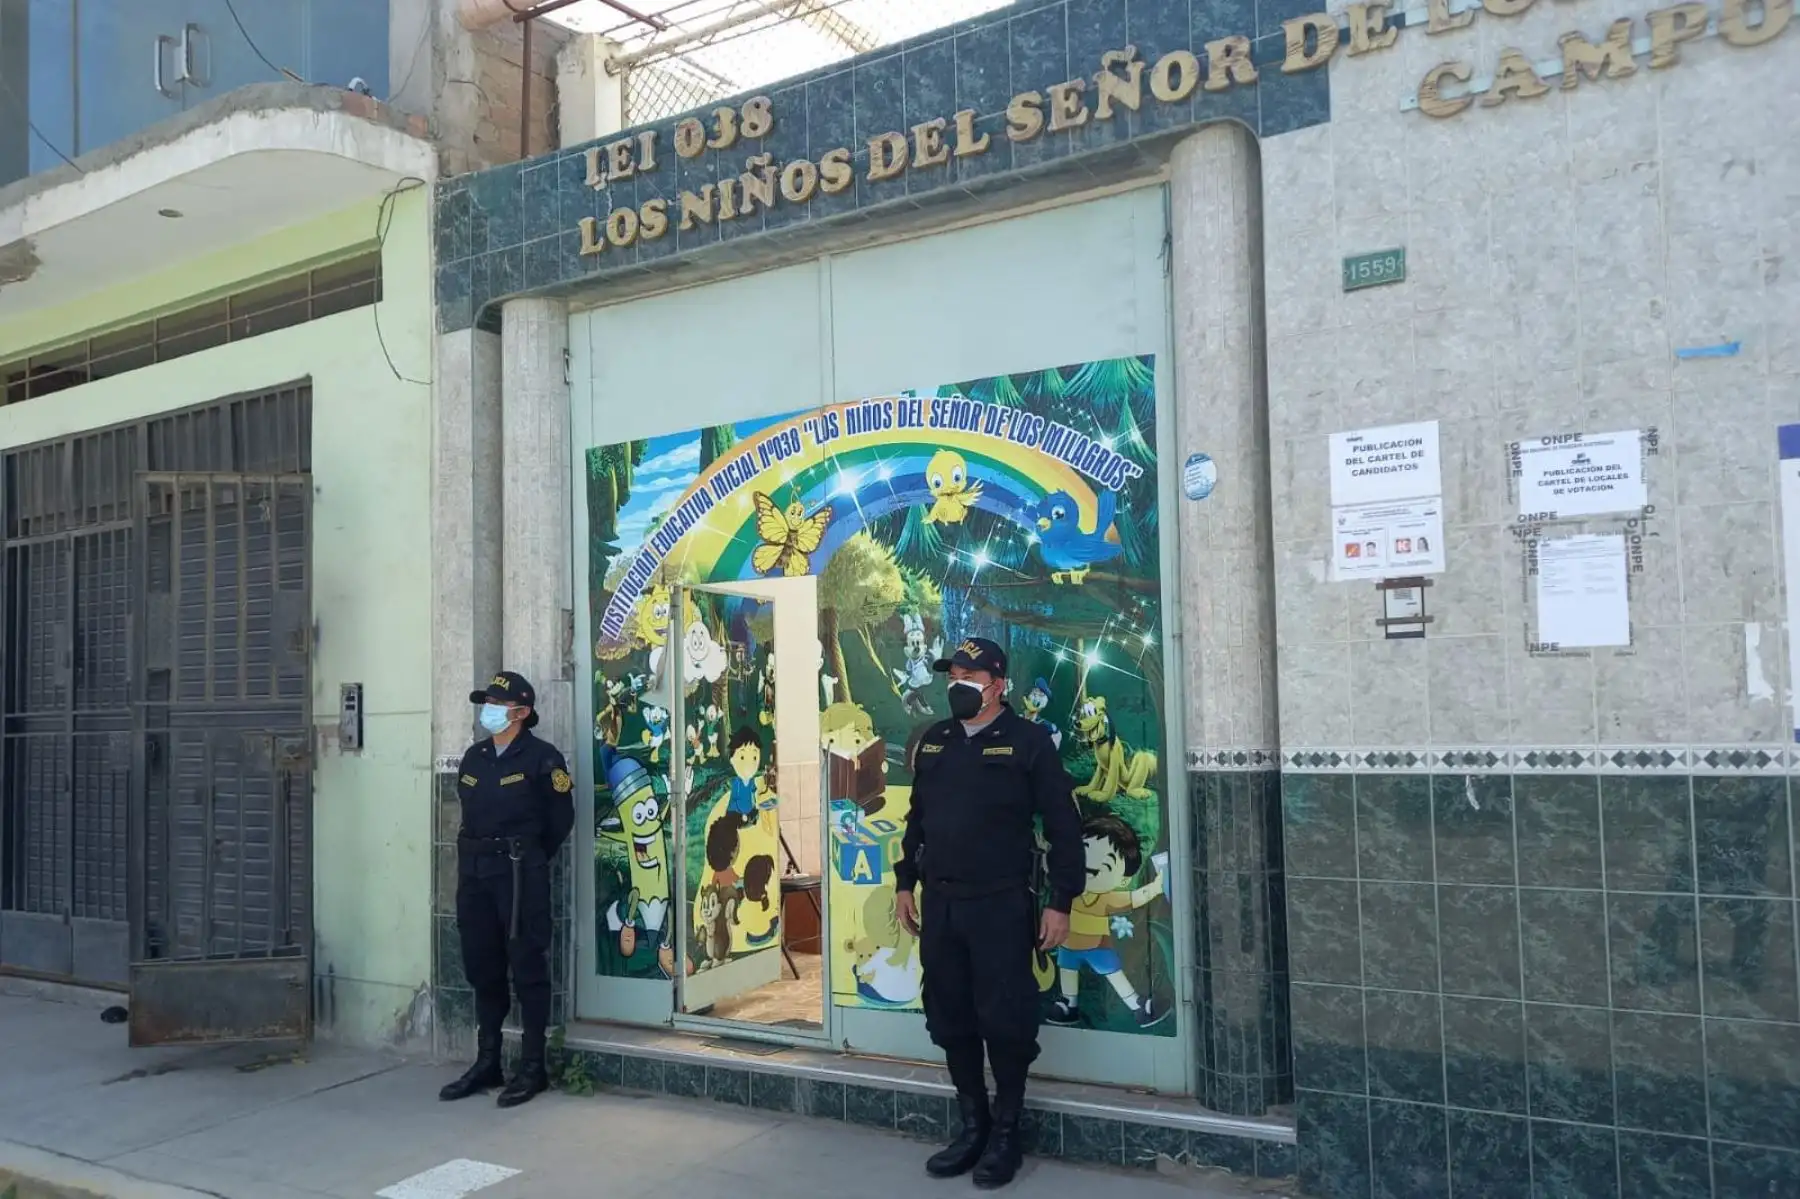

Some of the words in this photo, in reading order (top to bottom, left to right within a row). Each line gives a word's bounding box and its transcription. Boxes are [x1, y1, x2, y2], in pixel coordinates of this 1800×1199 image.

[1417, 0, 1794, 119] CAMPO
[579, 199, 668, 255] LOS
[680, 152, 852, 230] NIÑOS
[866, 109, 990, 182] DEL
[1006, 35, 1258, 142] SEÑOR
[1281, 0, 1397, 74] DE
[585, 131, 657, 190] IEI
[674, 96, 773, 158] 038
[1351, 256, 1396, 280] 1559
[1541, 432, 1583, 446] ONPE
[1345, 457, 1365, 466] DEL
[1367, 452, 1408, 463] CARTEL
[1411, 450, 1424, 459] DE
[1351, 463, 1419, 477] CANDIDATOS
[651, 487, 714, 557] EDUCATIVA
[709, 451, 760, 500] INICIAL
[846, 400, 893, 435] NIÑOS
[899, 399, 924, 428] DEL
[929, 395, 983, 432] SEÑOR
[984, 404, 1010, 437] DE
[1008, 409, 1044, 447] LOS
[1517, 511, 1558, 523] ONPE
[1631, 535, 1644, 573] ONPE
